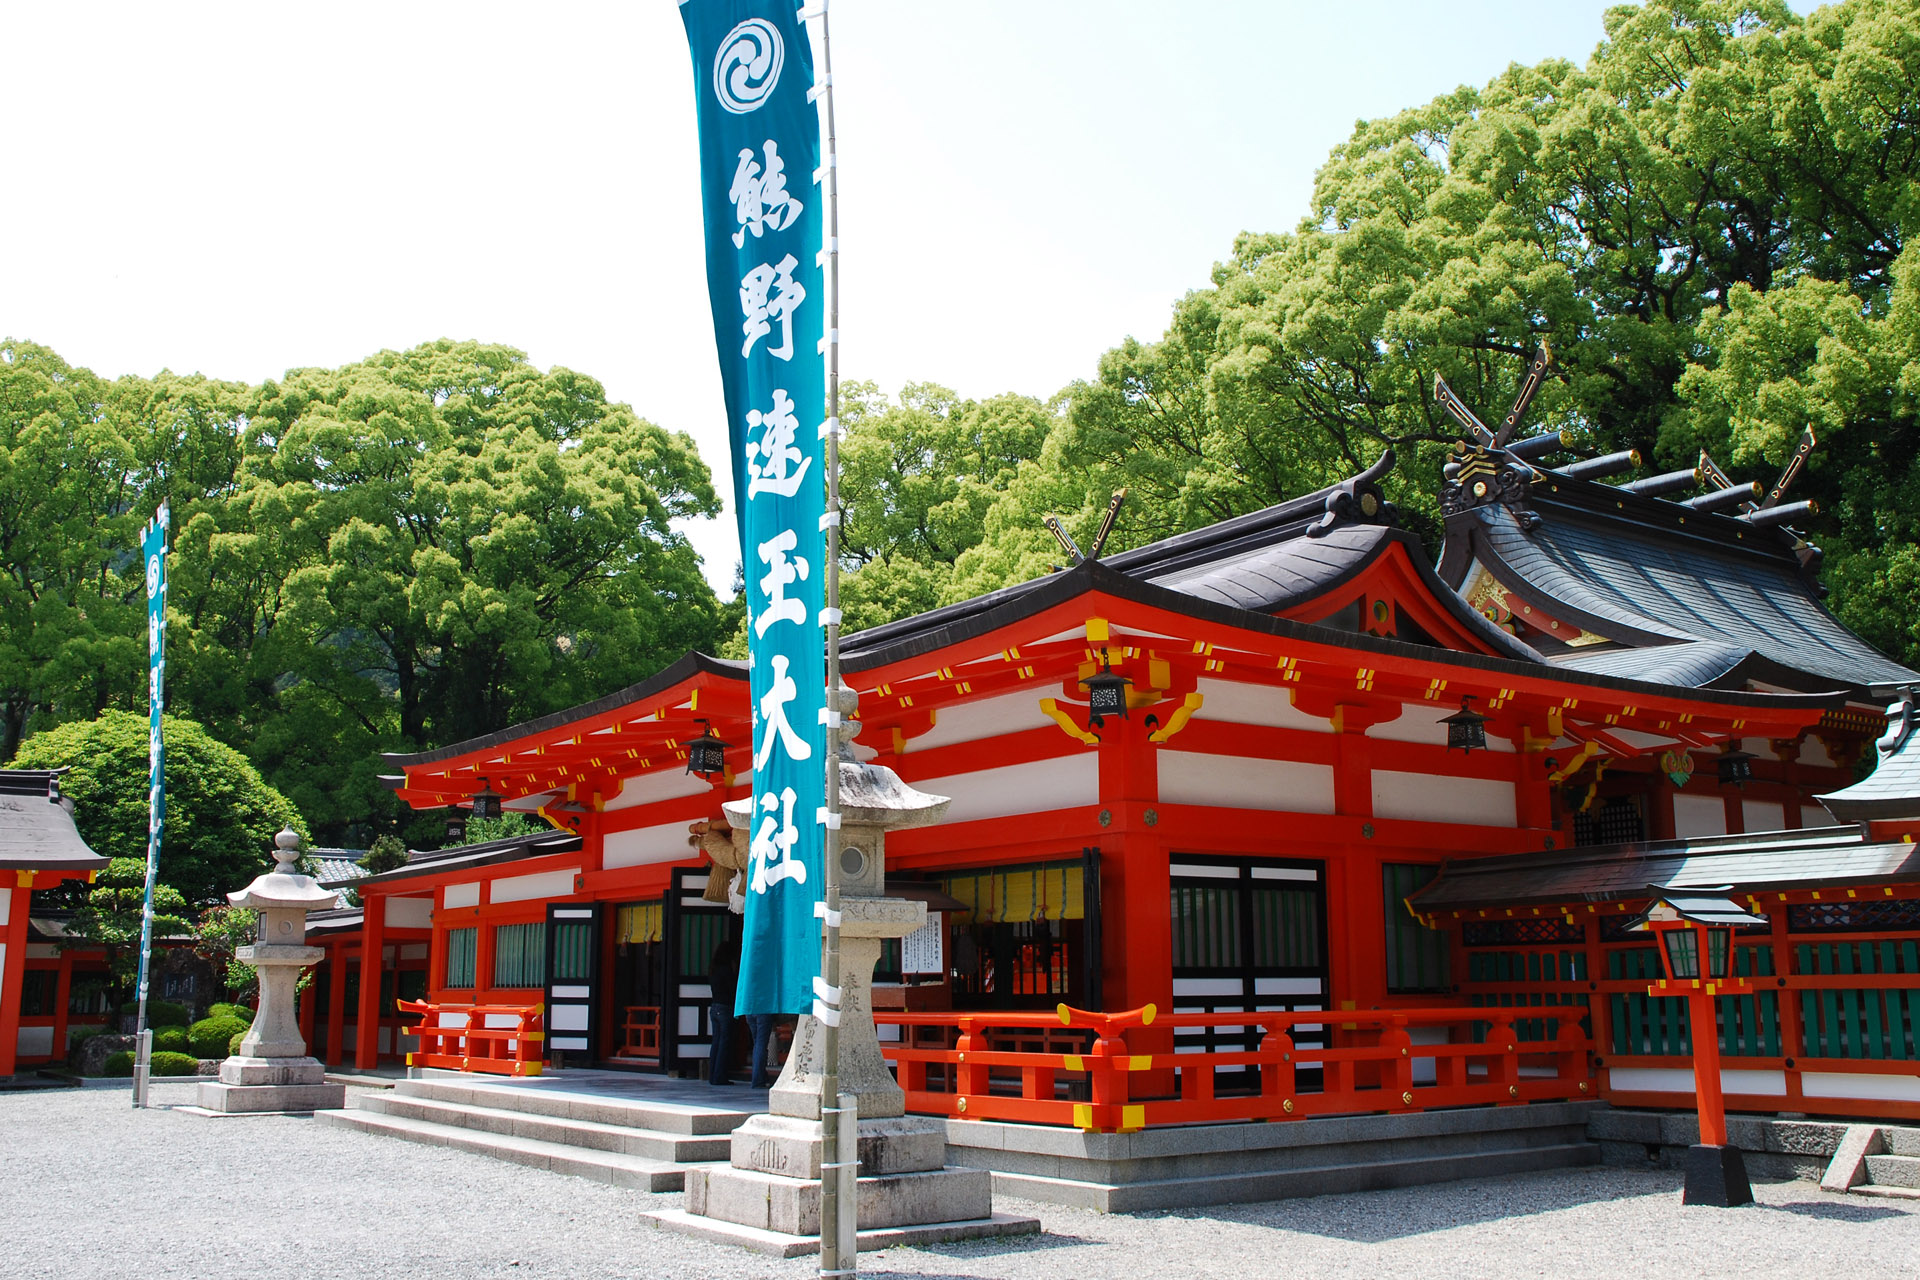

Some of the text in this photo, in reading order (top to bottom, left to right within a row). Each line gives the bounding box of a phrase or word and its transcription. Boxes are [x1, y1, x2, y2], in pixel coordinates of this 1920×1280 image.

[730, 139, 811, 895] 熊野速玉大社
